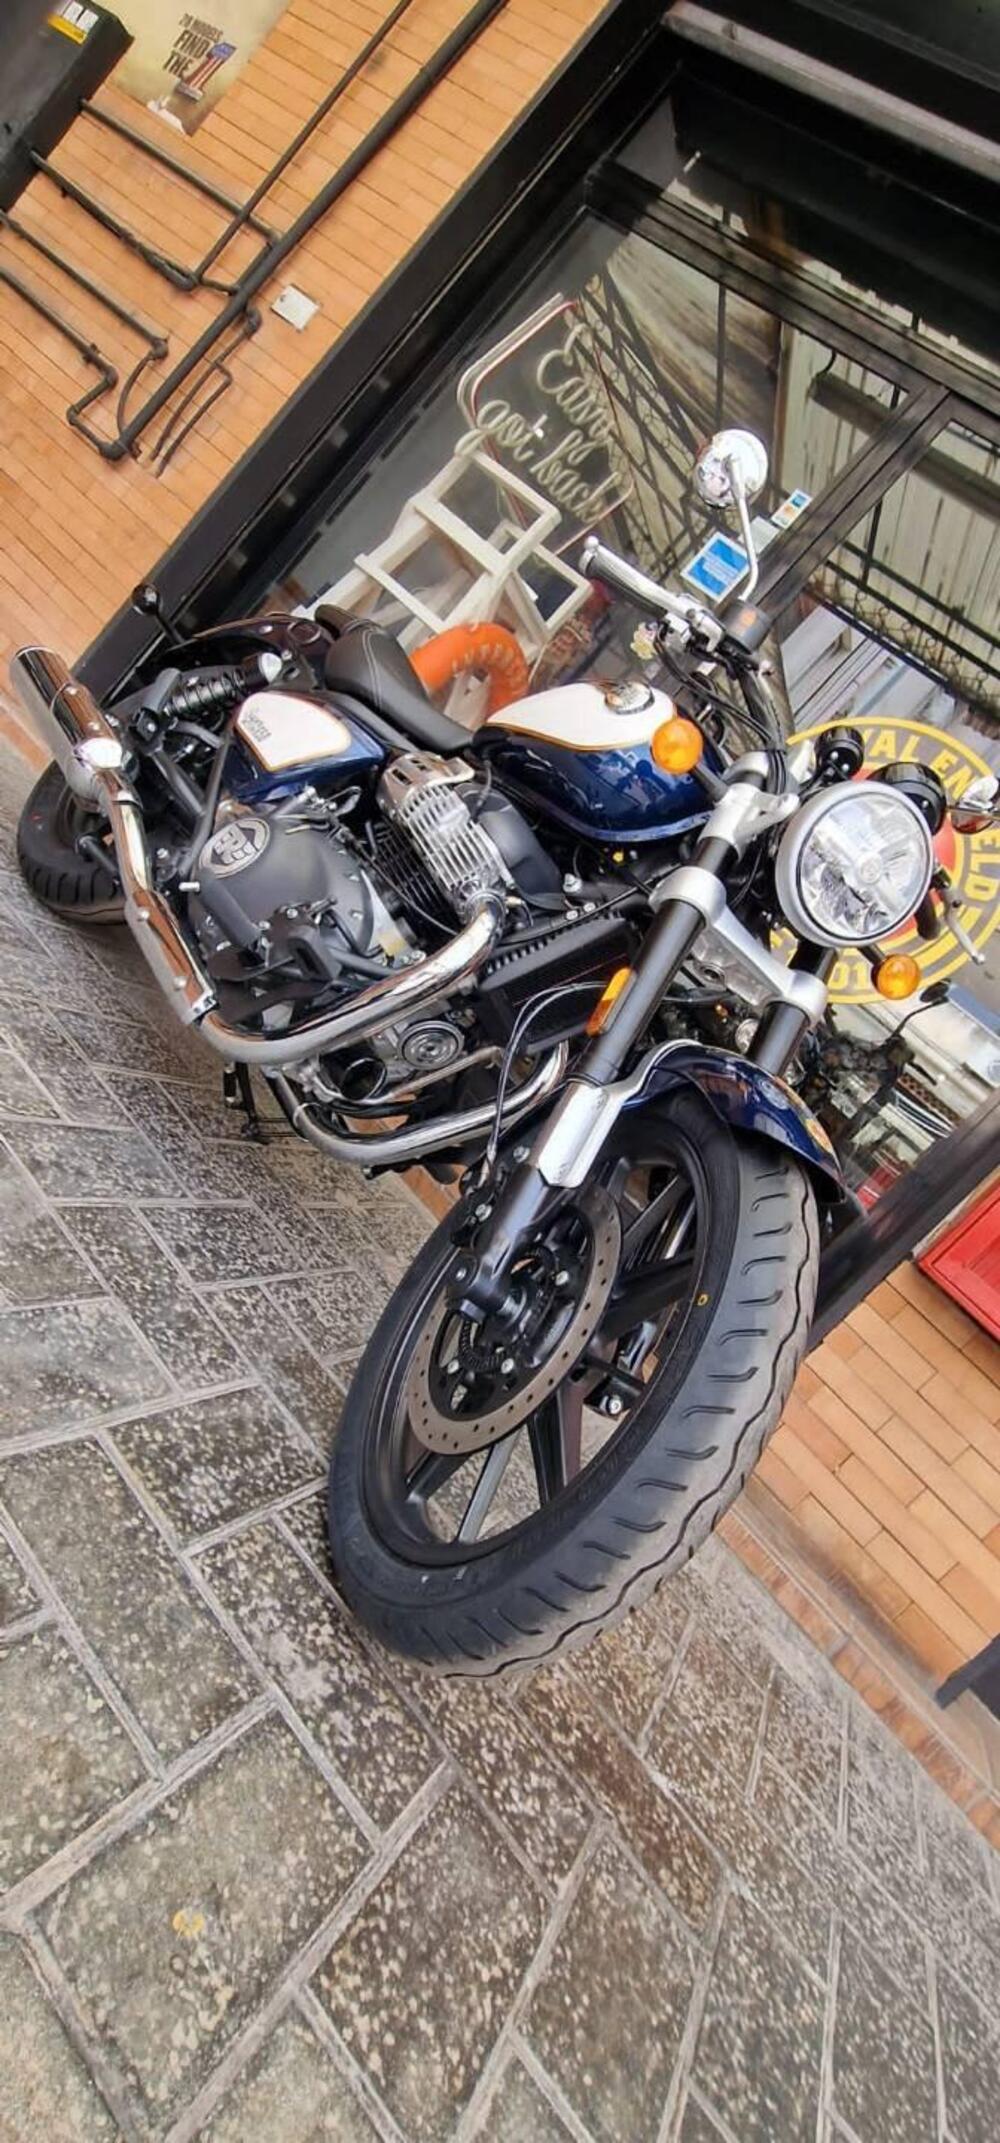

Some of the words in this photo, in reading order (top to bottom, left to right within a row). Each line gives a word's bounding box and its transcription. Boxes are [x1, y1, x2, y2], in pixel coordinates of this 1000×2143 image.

[162, 50, 195, 79] THE
[173, 28, 211, 60] FIND
[454, 398, 549, 462] got
[529, 428, 622, 525] back
[928, 748, 1000, 903] ENELD
